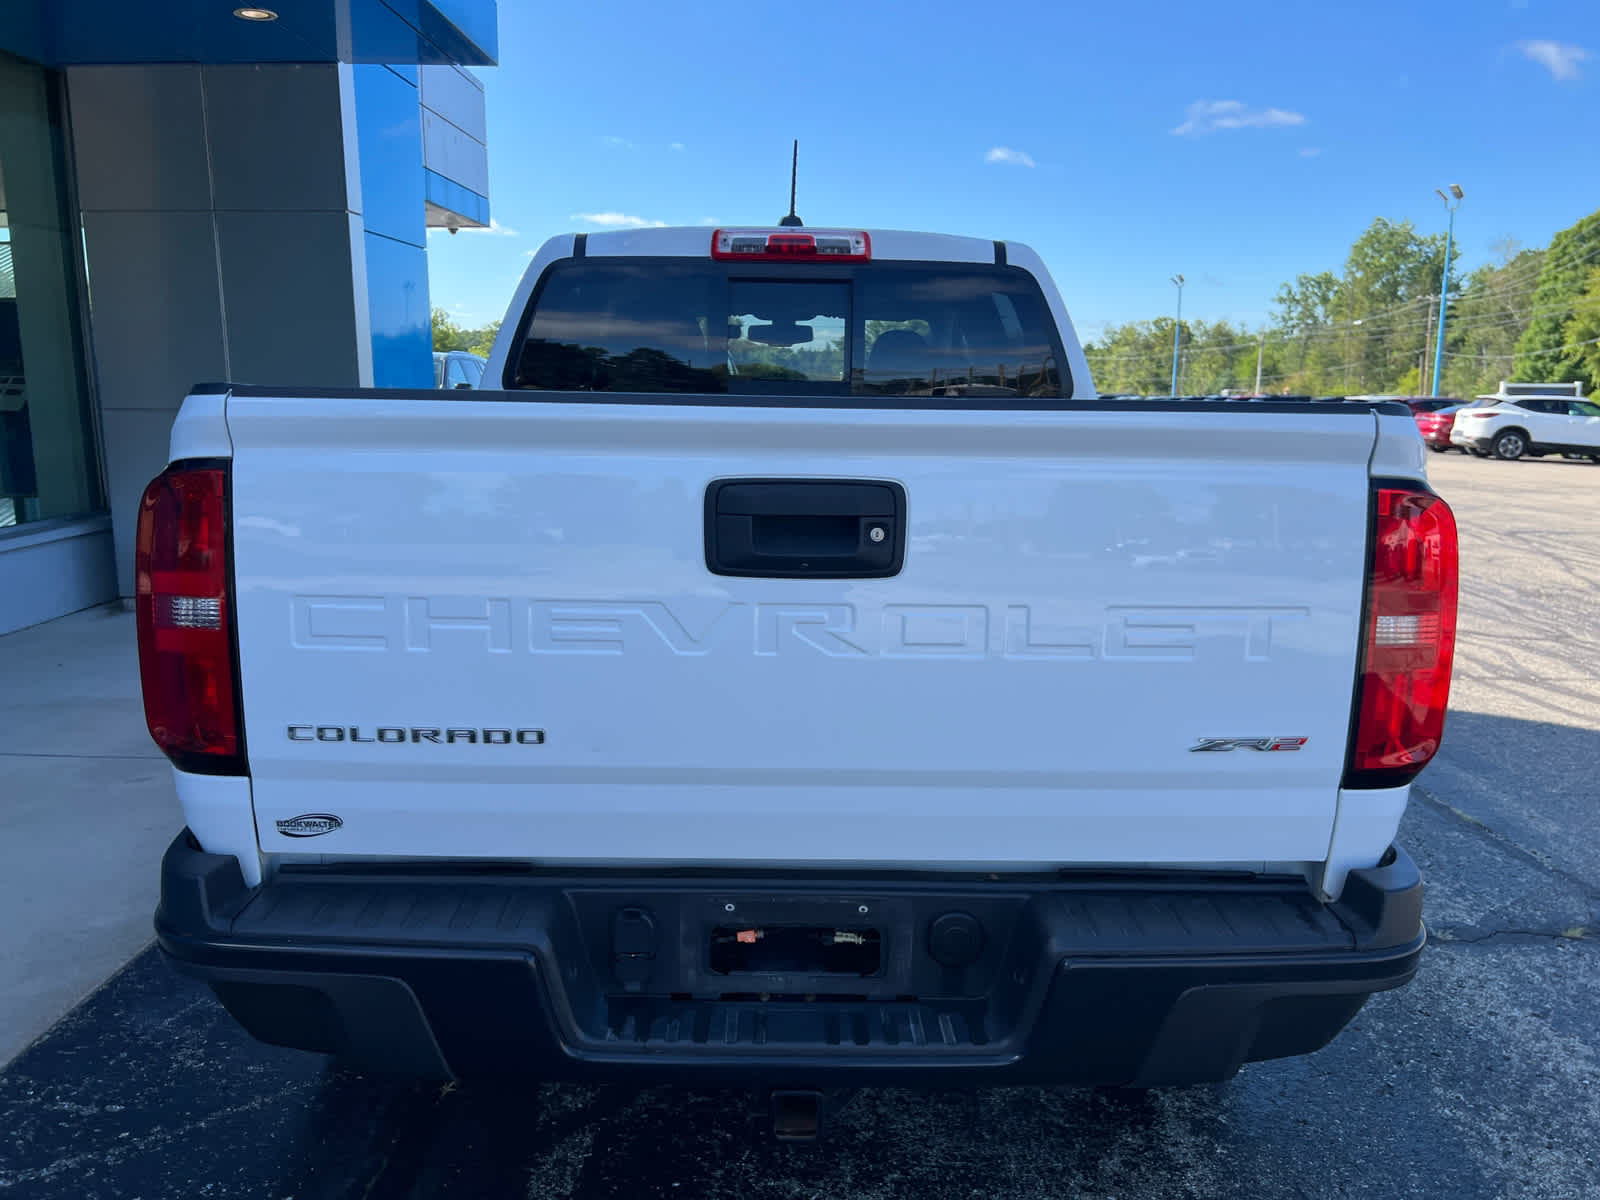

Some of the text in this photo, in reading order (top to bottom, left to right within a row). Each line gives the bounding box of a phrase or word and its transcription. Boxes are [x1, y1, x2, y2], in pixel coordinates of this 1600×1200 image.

[289, 594, 1310, 663] CHEVROLET
[287, 725, 546, 744] COLORADO
[1189, 736, 1309, 752] ZR2
[276, 819, 342, 829] BOOKWALTER
